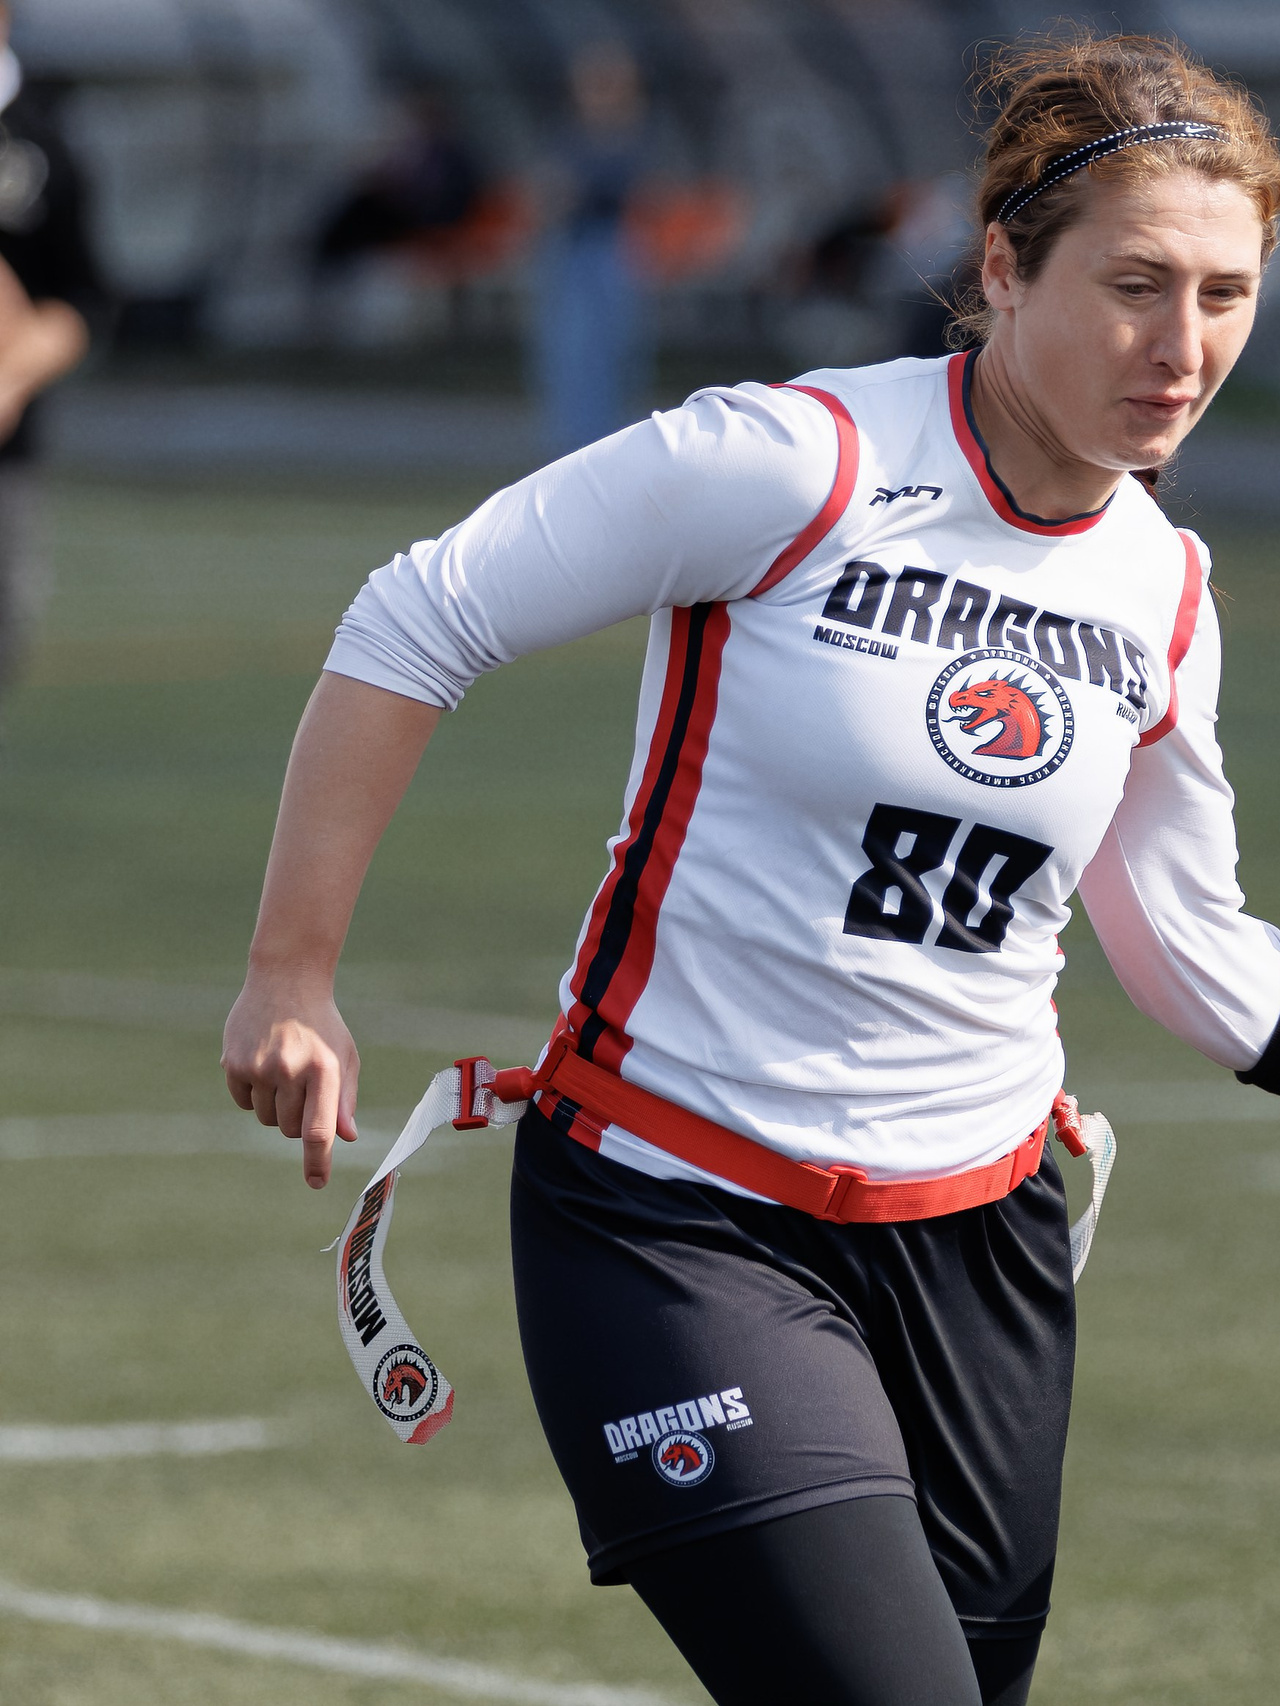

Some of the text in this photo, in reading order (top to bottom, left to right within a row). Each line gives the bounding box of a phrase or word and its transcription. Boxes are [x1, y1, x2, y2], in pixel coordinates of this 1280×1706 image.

[813, 625, 899, 660] MOSCOW
[821, 561, 1147, 710] DRAGONS
[842, 802, 1055, 953] 80
[603, 1387, 750, 1455] DRAGONS
